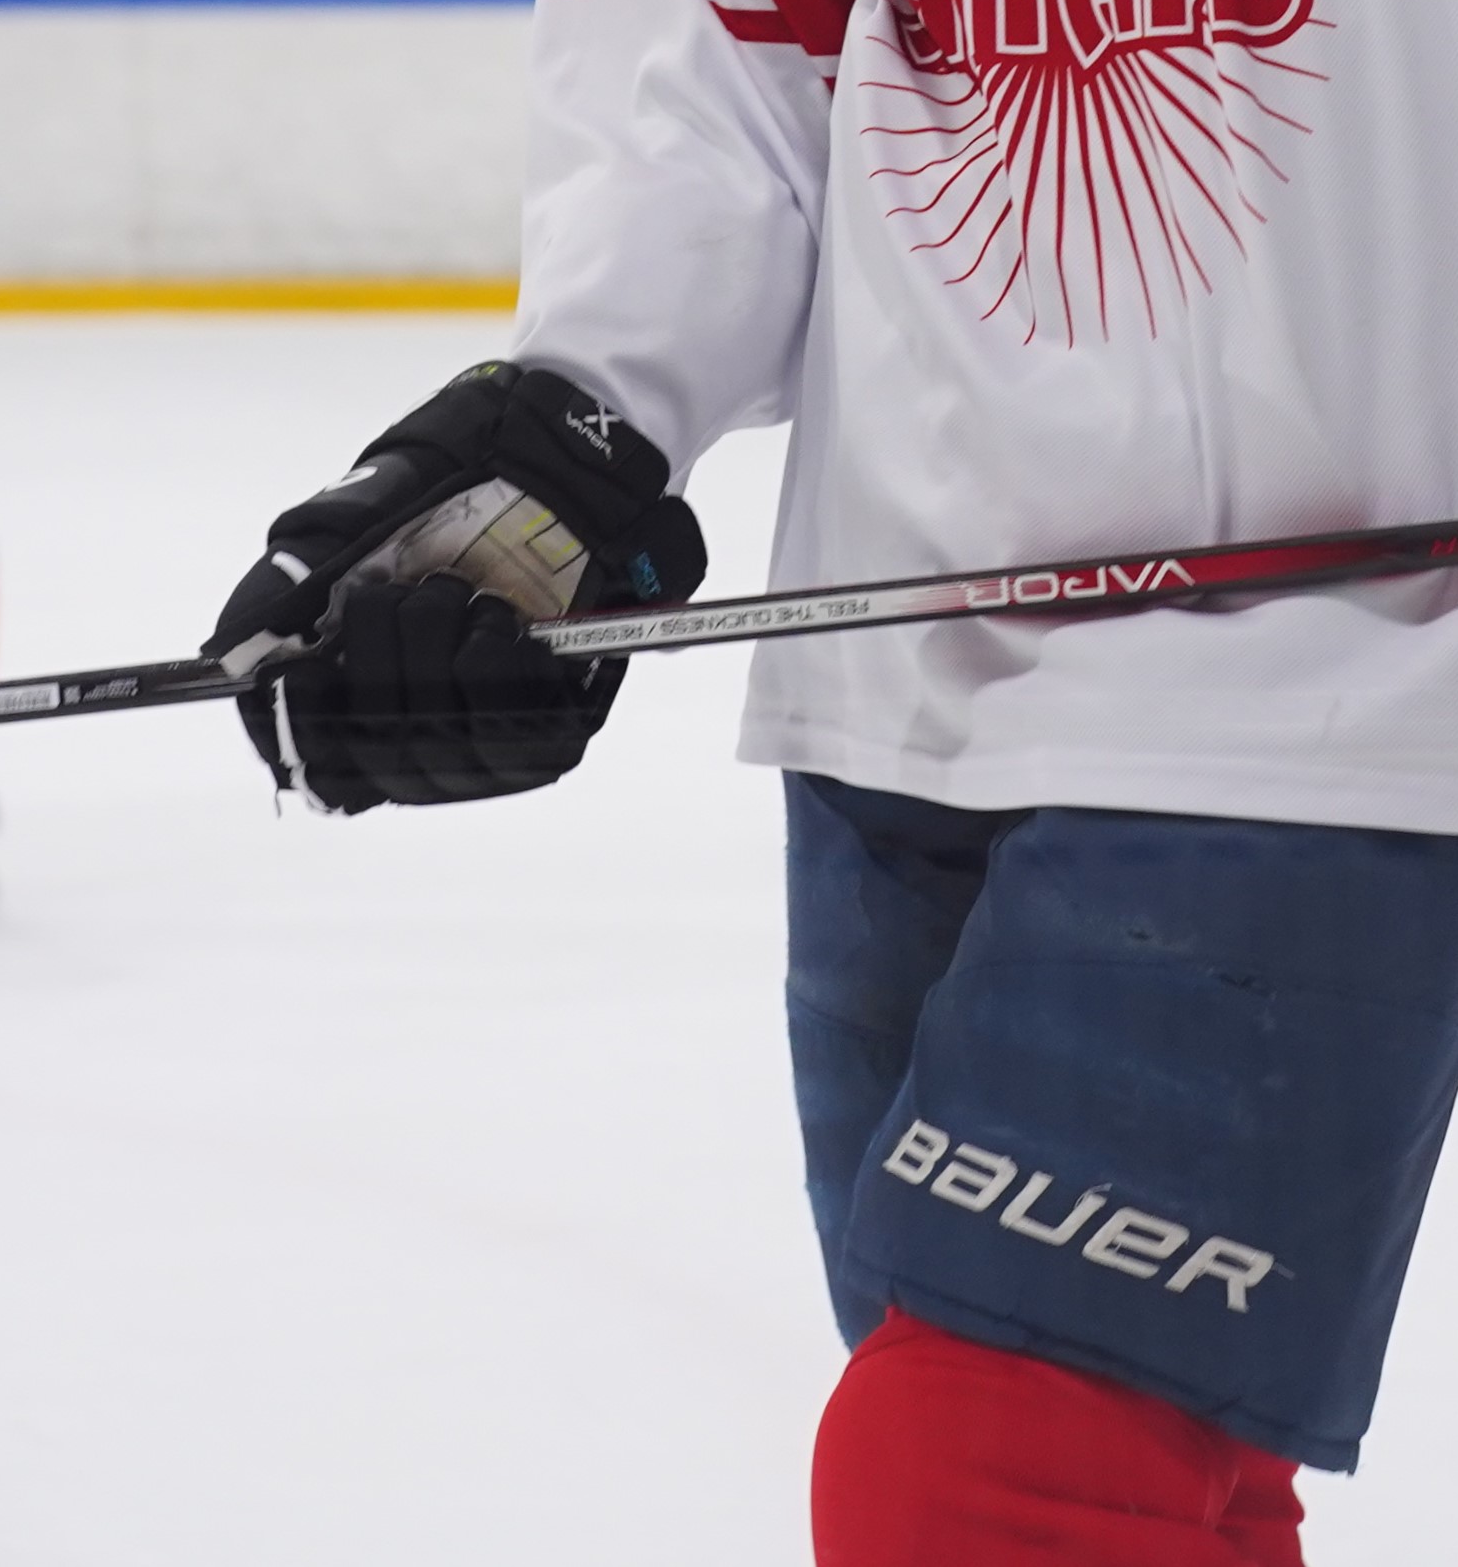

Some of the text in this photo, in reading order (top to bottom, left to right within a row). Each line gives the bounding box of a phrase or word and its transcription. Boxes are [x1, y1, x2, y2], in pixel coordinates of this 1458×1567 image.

[964, 558, 1196, 609] VAPOR
[778, 605, 816, 623] THE
[881, 1119, 1276, 1313] BAUER
